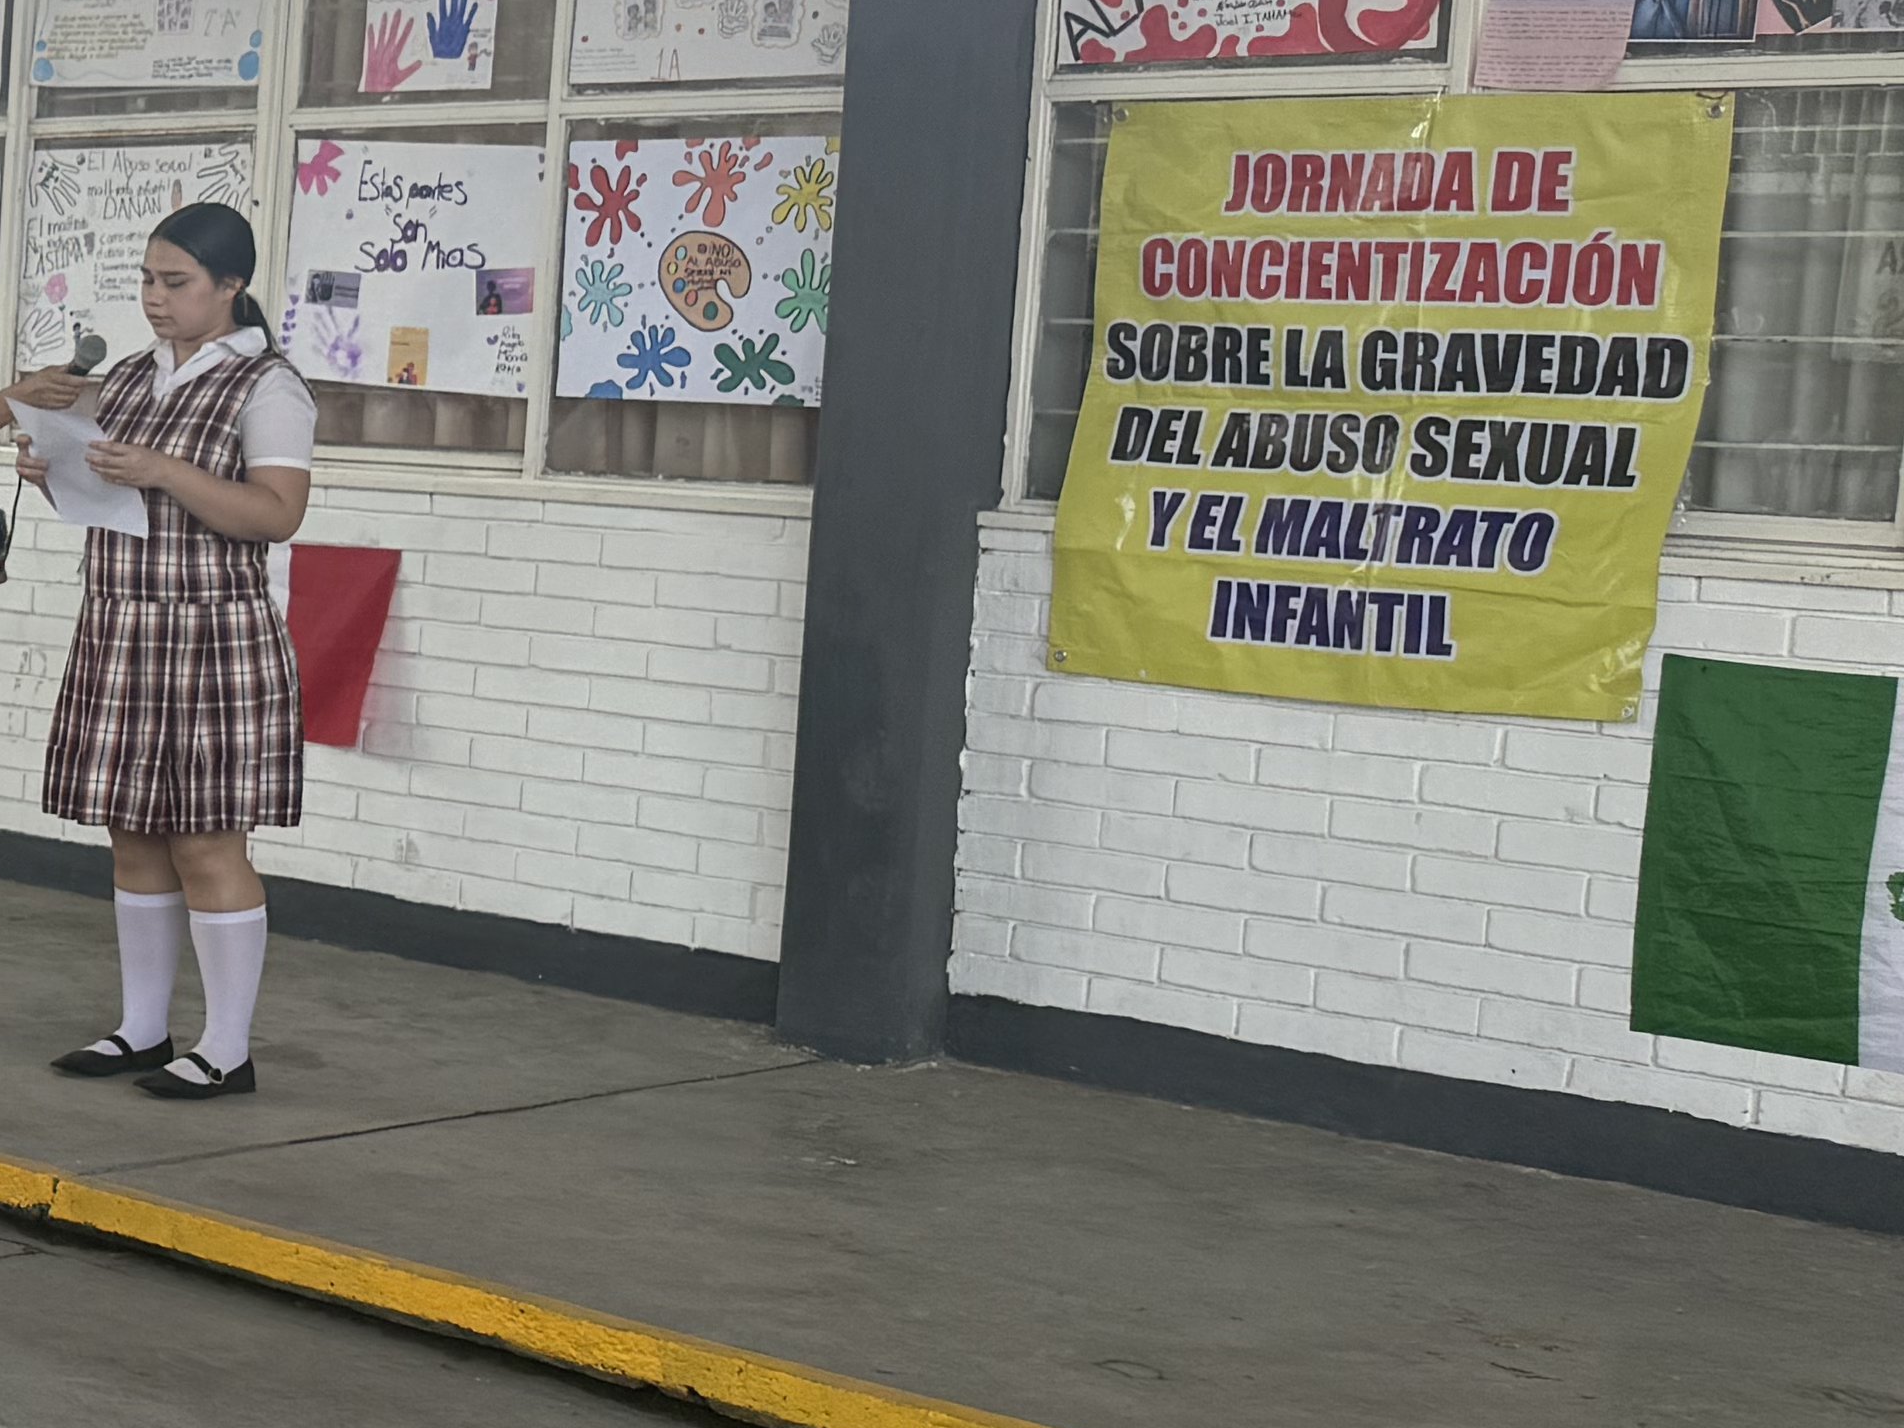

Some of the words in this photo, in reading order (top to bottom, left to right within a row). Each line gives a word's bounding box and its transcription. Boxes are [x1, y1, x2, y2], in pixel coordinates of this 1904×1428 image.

[1224, 149, 1476, 214] JORNADA
[1492, 148, 1573, 213] DE
[1141, 231, 1662, 306] CONCIENTIZACIÓN
[1106, 323, 1271, 386] SOBRE
[1284, 328, 1346, 391] LA
[1360, 332, 1689, 400] GRAVEDAD
[1110, 406, 1202, 466] DEL
[1210, 412, 1399, 474] ABUSO
[1408, 416, 1639, 488] SEXUAL
[1148, 490, 1187, 548] Y
[1190, 493, 1246, 552] EL
[1254, 498, 1556, 573] MALTRATO
[1210, 580, 1456, 657] INFANTIL
